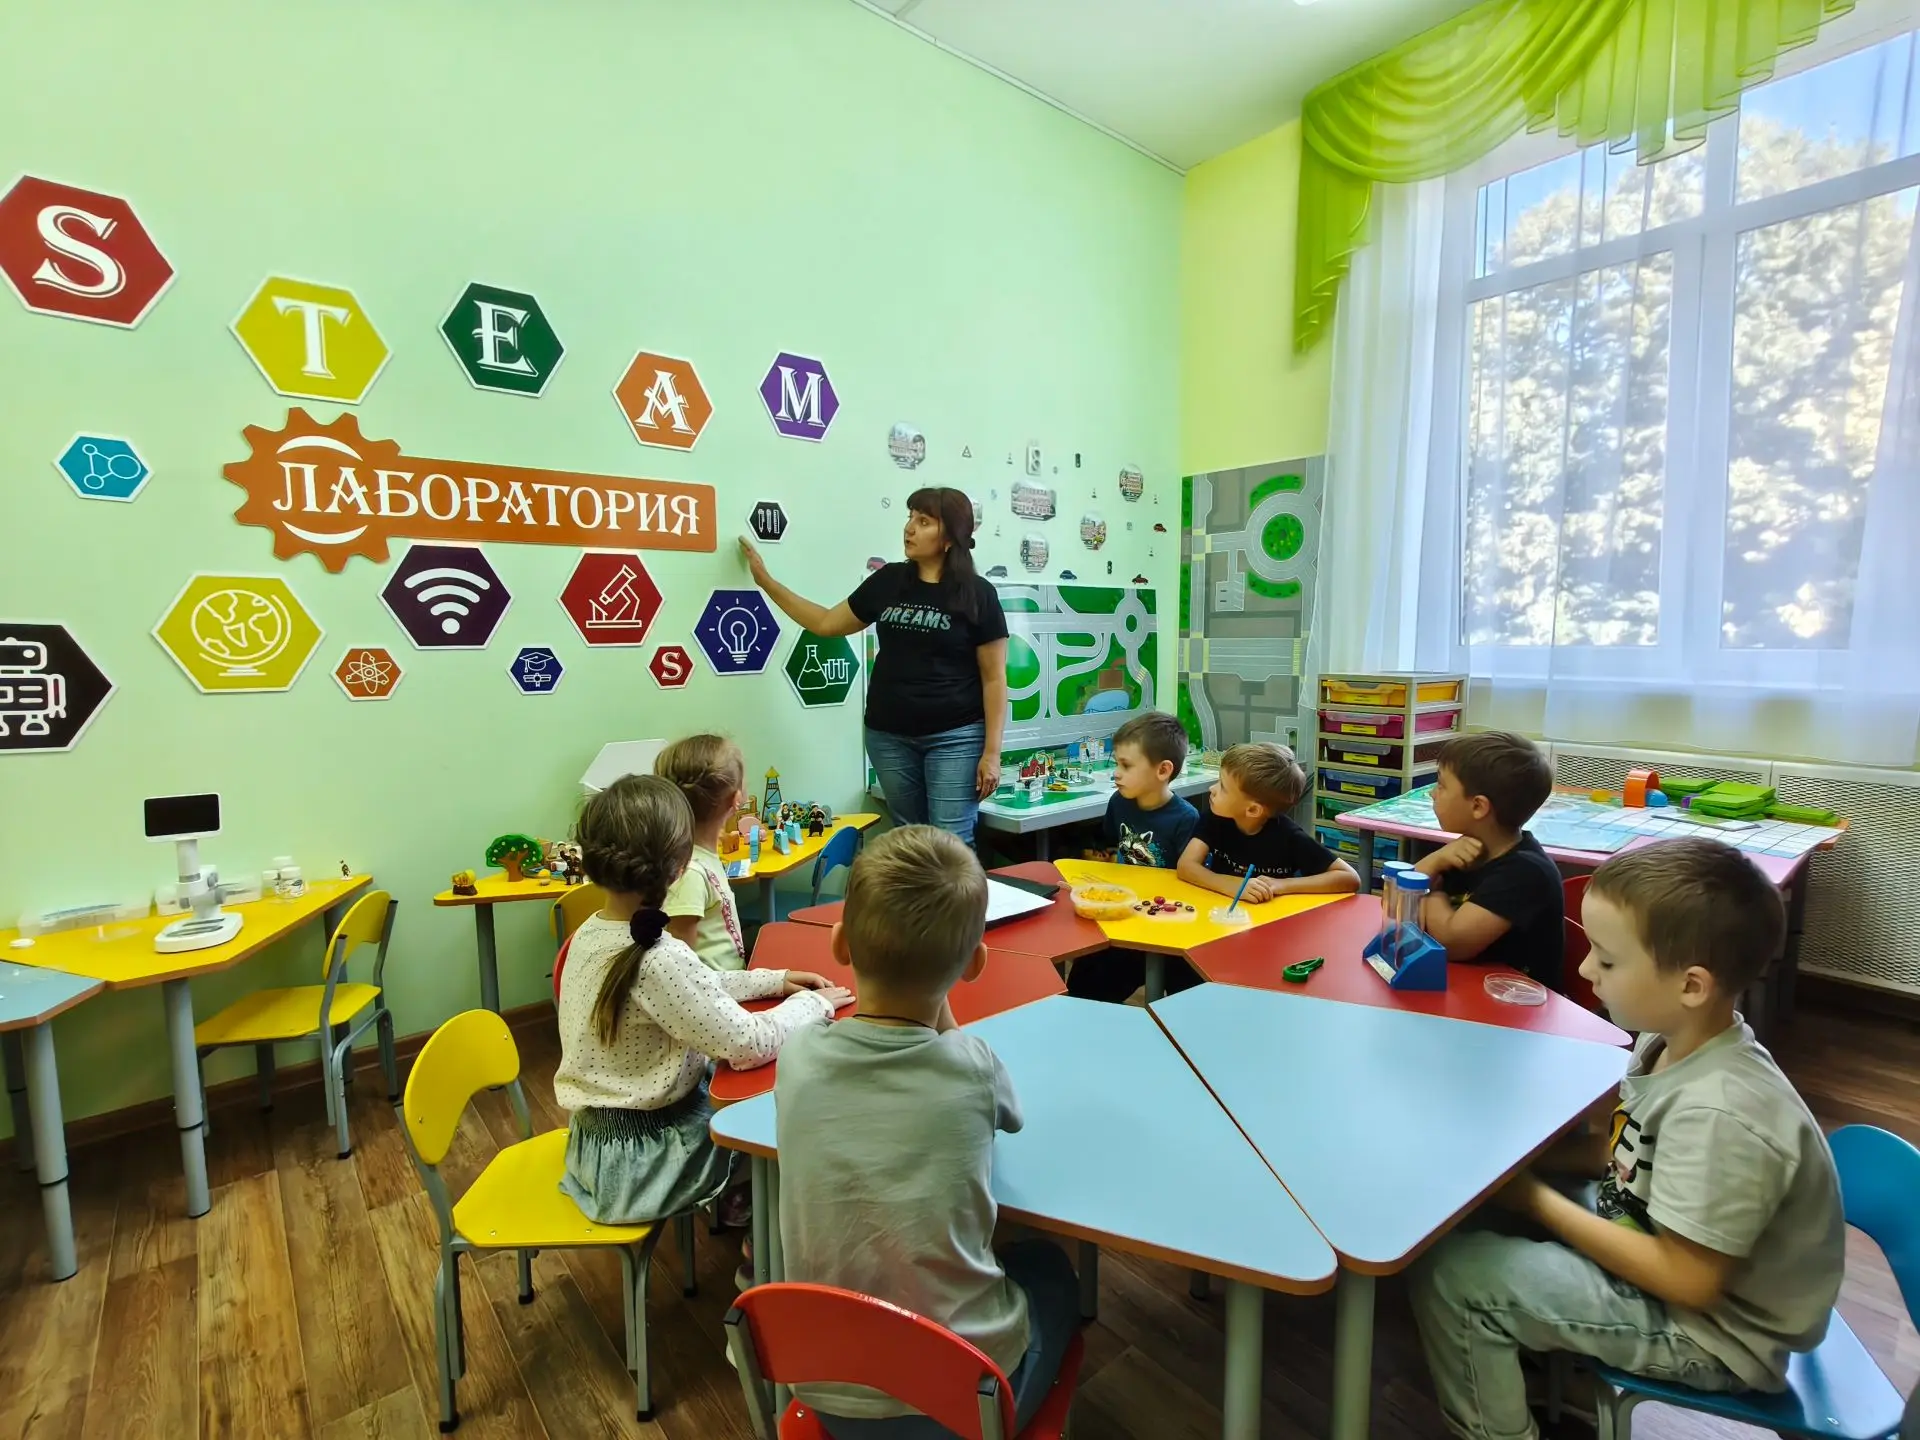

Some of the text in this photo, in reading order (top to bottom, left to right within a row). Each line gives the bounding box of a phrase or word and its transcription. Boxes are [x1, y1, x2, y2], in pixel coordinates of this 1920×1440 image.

[33, 205, 826, 436] S T E A M
[272, 461, 700, 537] ЛАБОРАТОРИЯ
[880, 606, 952, 631] DREAMS
[661, 651, 683, 680] S
